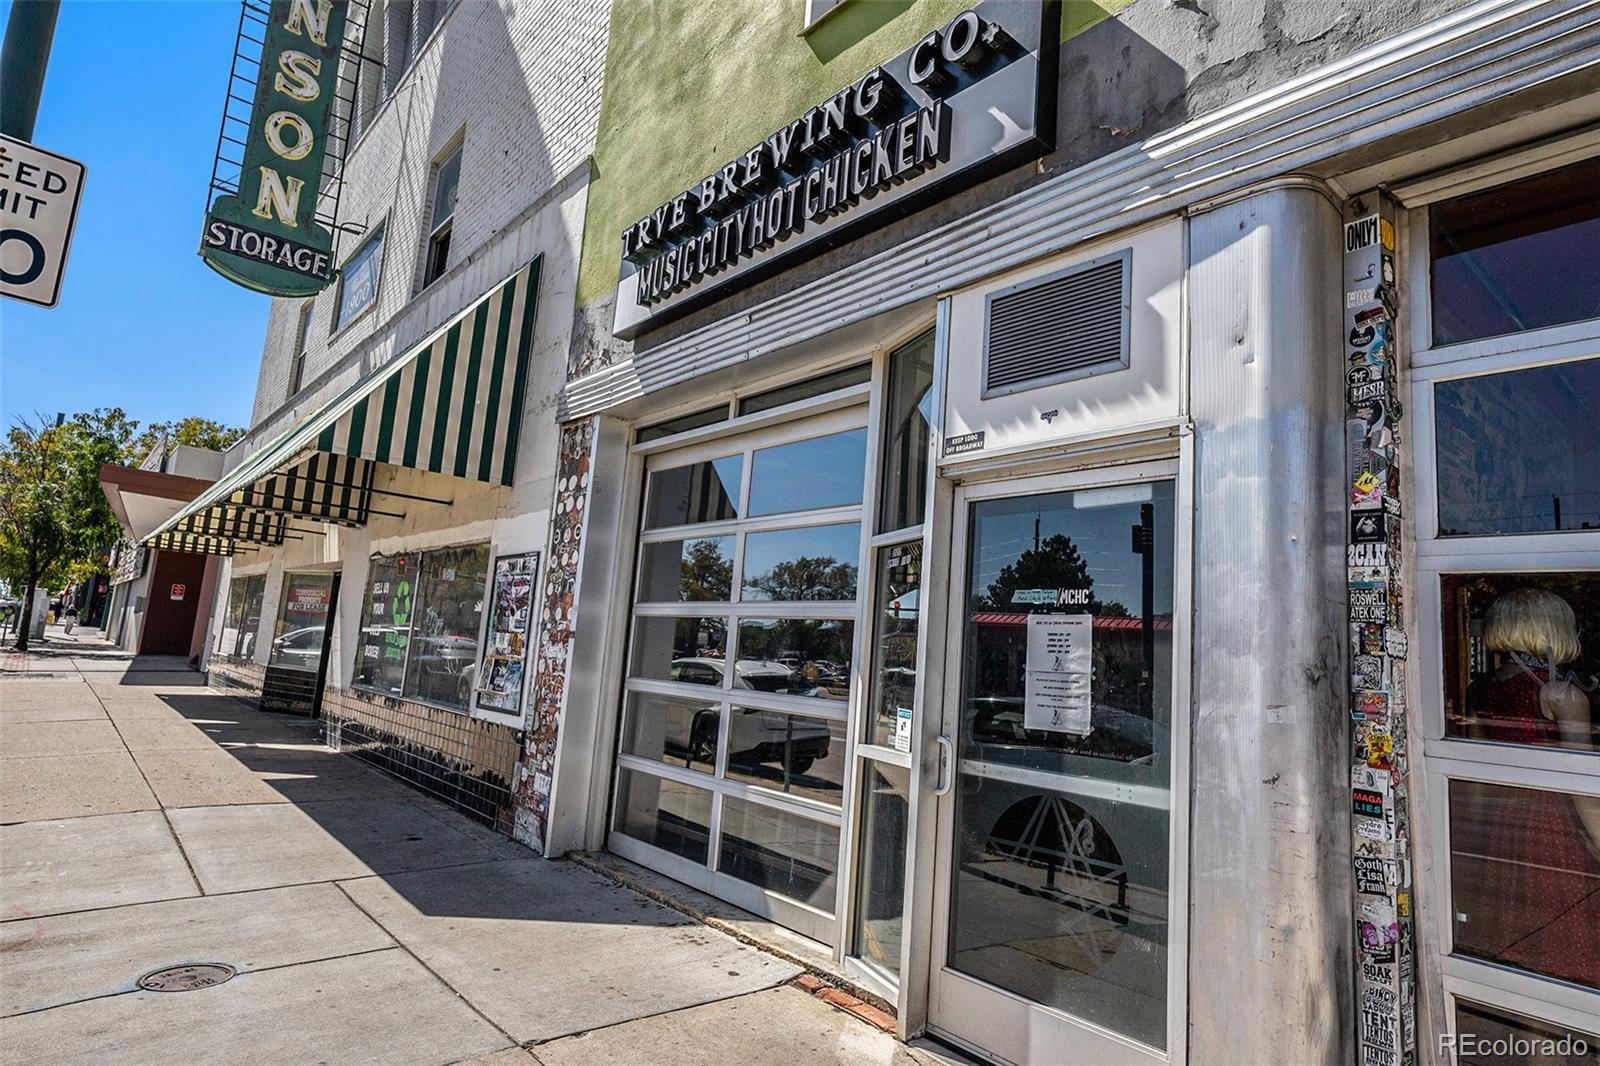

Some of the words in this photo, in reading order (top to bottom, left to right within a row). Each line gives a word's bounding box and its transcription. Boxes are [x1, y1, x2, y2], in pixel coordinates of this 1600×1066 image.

[621, 190, 690, 260] TRVE
[697, 65, 885, 214] BREWING
[636, 237, 698, 305] MUSIC
[749, 176, 802, 248] HOT
[802, 97, 943, 220] CHICKEN
[208, 222, 330, 278] STORAGE
[1350, 593, 1386, 606] ROSWELL
[1370, 607, 1386, 619] ONE
[1353, 792, 1383, 804] MAGA
[1355, 802, 1382, 814] LIES
[1354, 858, 1383, 873] Goth
[1357, 869, 1384, 882] Lisa
[1358, 879, 1386, 893] Frank
[1363, 963, 1393, 980] SOAK
